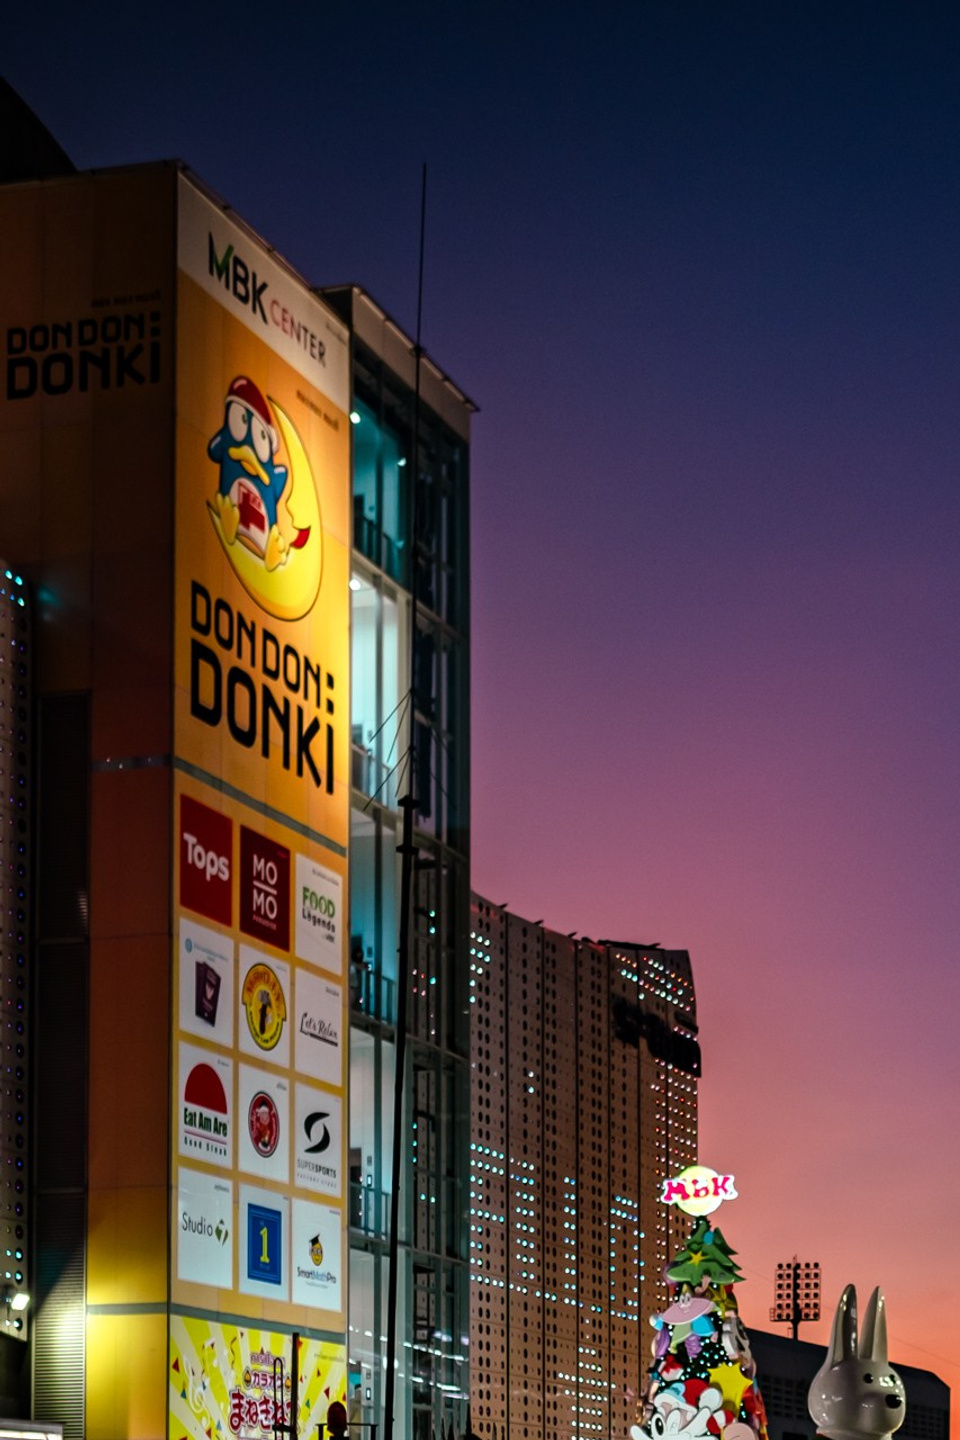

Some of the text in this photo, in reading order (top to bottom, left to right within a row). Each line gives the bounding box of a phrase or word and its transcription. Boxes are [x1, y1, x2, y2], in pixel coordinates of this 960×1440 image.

[208, 231, 327, 368] MBK CENTER
[7, 321, 73, 355] DON
[7, 341, 161, 400] DONKI
[191, 579, 256, 669] DON
[190, 638, 334, 795] DONKI
[183, 832, 230, 882] Tops
[252, 854, 278, 885] MO
[252, 888, 278, 919] MO
[302, 886, 336, 919] FOOD
[184, 1107, 228, 1137] Eat Am Are
[297, 1158, 337, 1178] SUPERSPORTS
[182, 1211, 213, 1237] Studio
[259, 1226, 270, 1264] 1
[297, 1266, 337, 1284] SmartMathPro
[230, 1389, 297, 1432] まねきね
